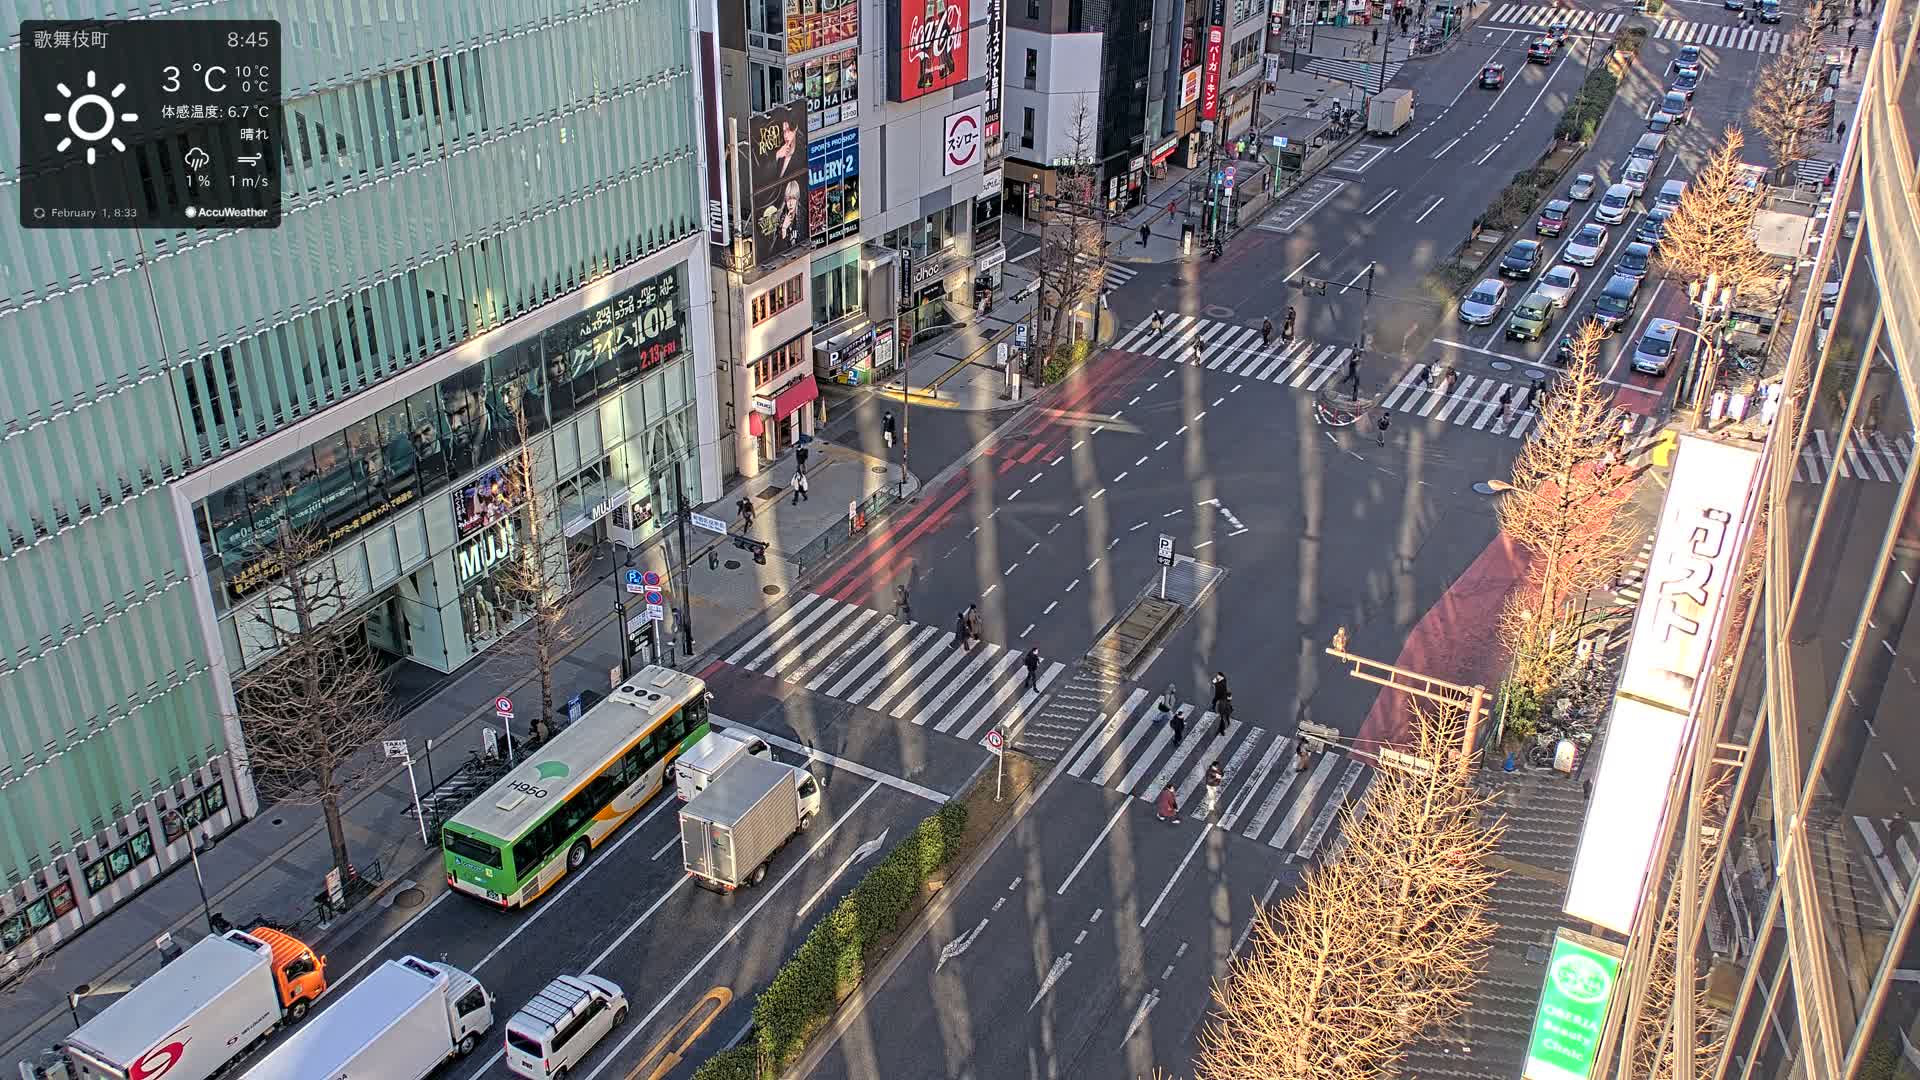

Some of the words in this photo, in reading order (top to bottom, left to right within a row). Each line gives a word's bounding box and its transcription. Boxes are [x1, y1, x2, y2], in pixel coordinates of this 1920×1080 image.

[1206, 45, 1220, 110] バーガーキング
[948, 133, 979, 151] スシロー
[710, 200, 722, 232] MUJI
[1018, 326, 1025, 335] P
[592, 497, 615, 520] MUJI
[459, 519, 515, 581] MUJI
[1161, 539, 1169, 548] P
[629, 573, 637, 582] P
[507, 780, 548, 799] H950
